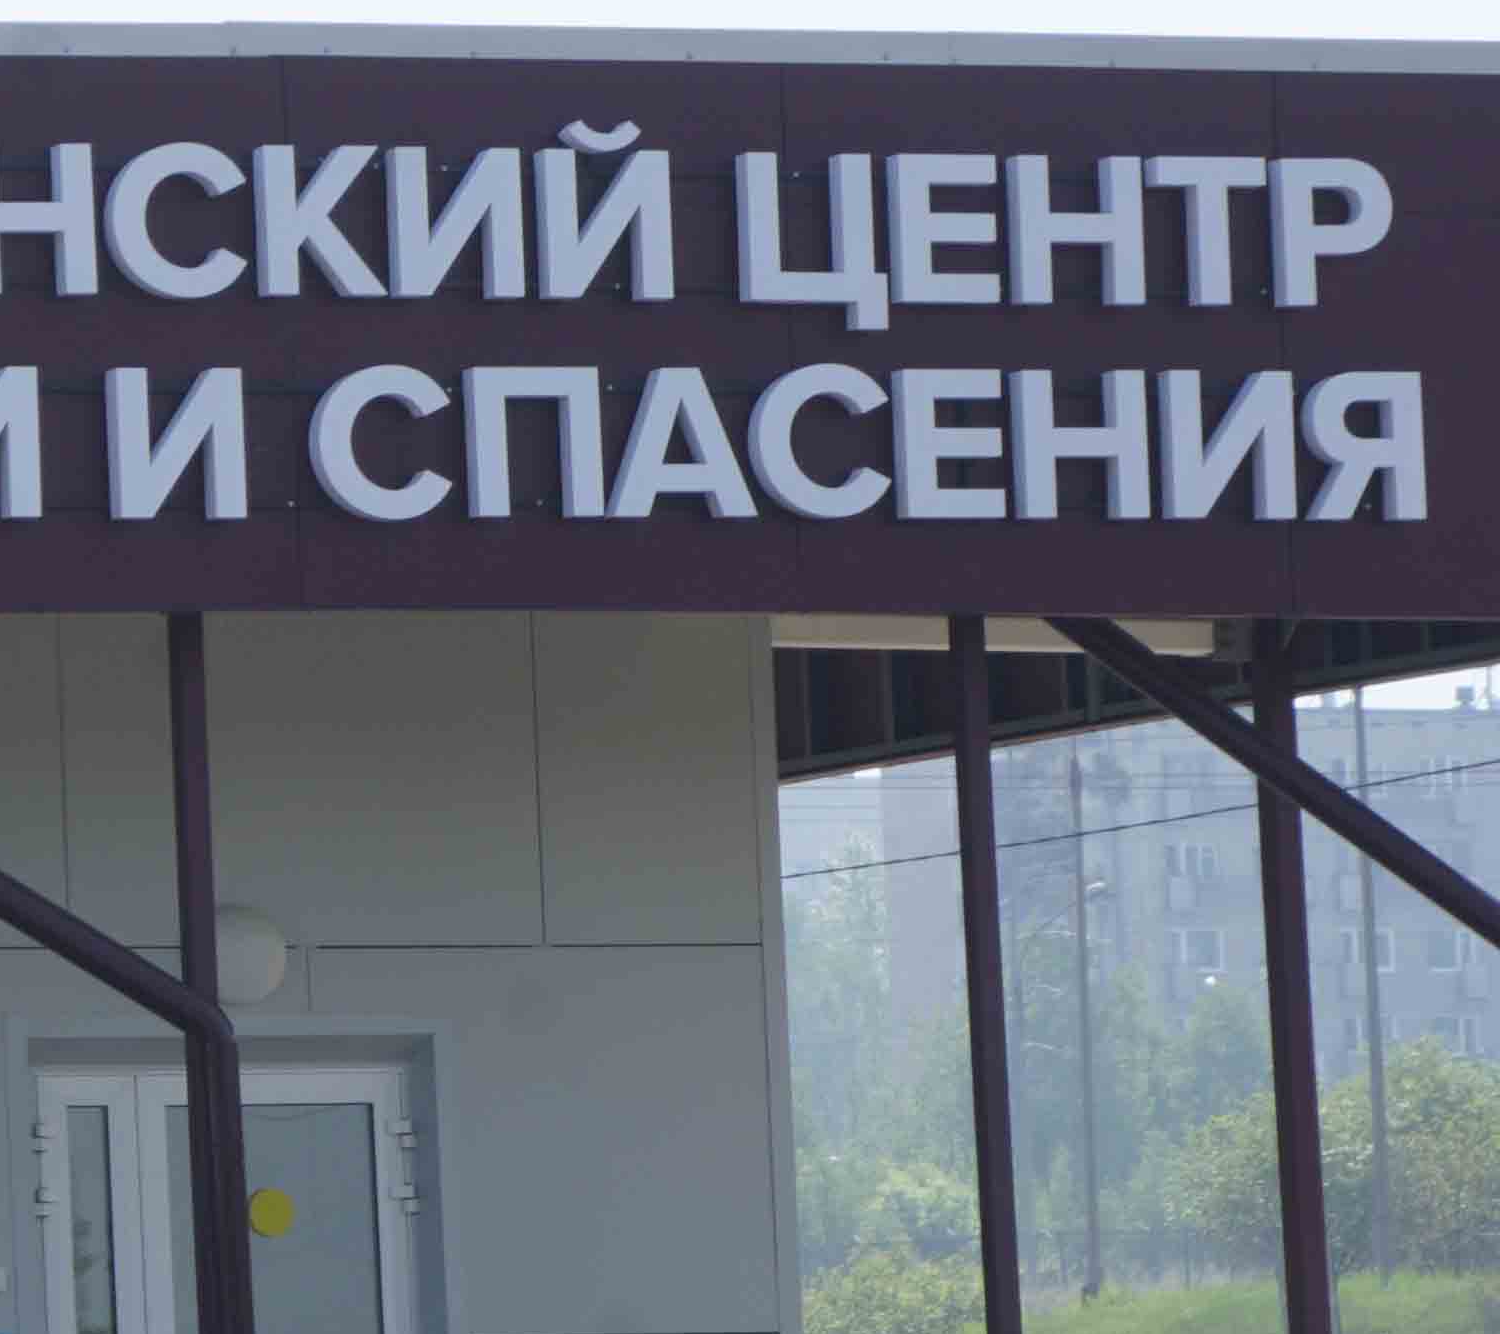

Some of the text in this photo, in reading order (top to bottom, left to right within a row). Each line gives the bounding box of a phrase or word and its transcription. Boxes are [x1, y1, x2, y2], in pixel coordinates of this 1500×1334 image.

[738, 151, 1393, 330] ЦЕНТР
[106, 366, 248, 520] И
[310, 362, 1429, 524] СПАСЕНИЯ
